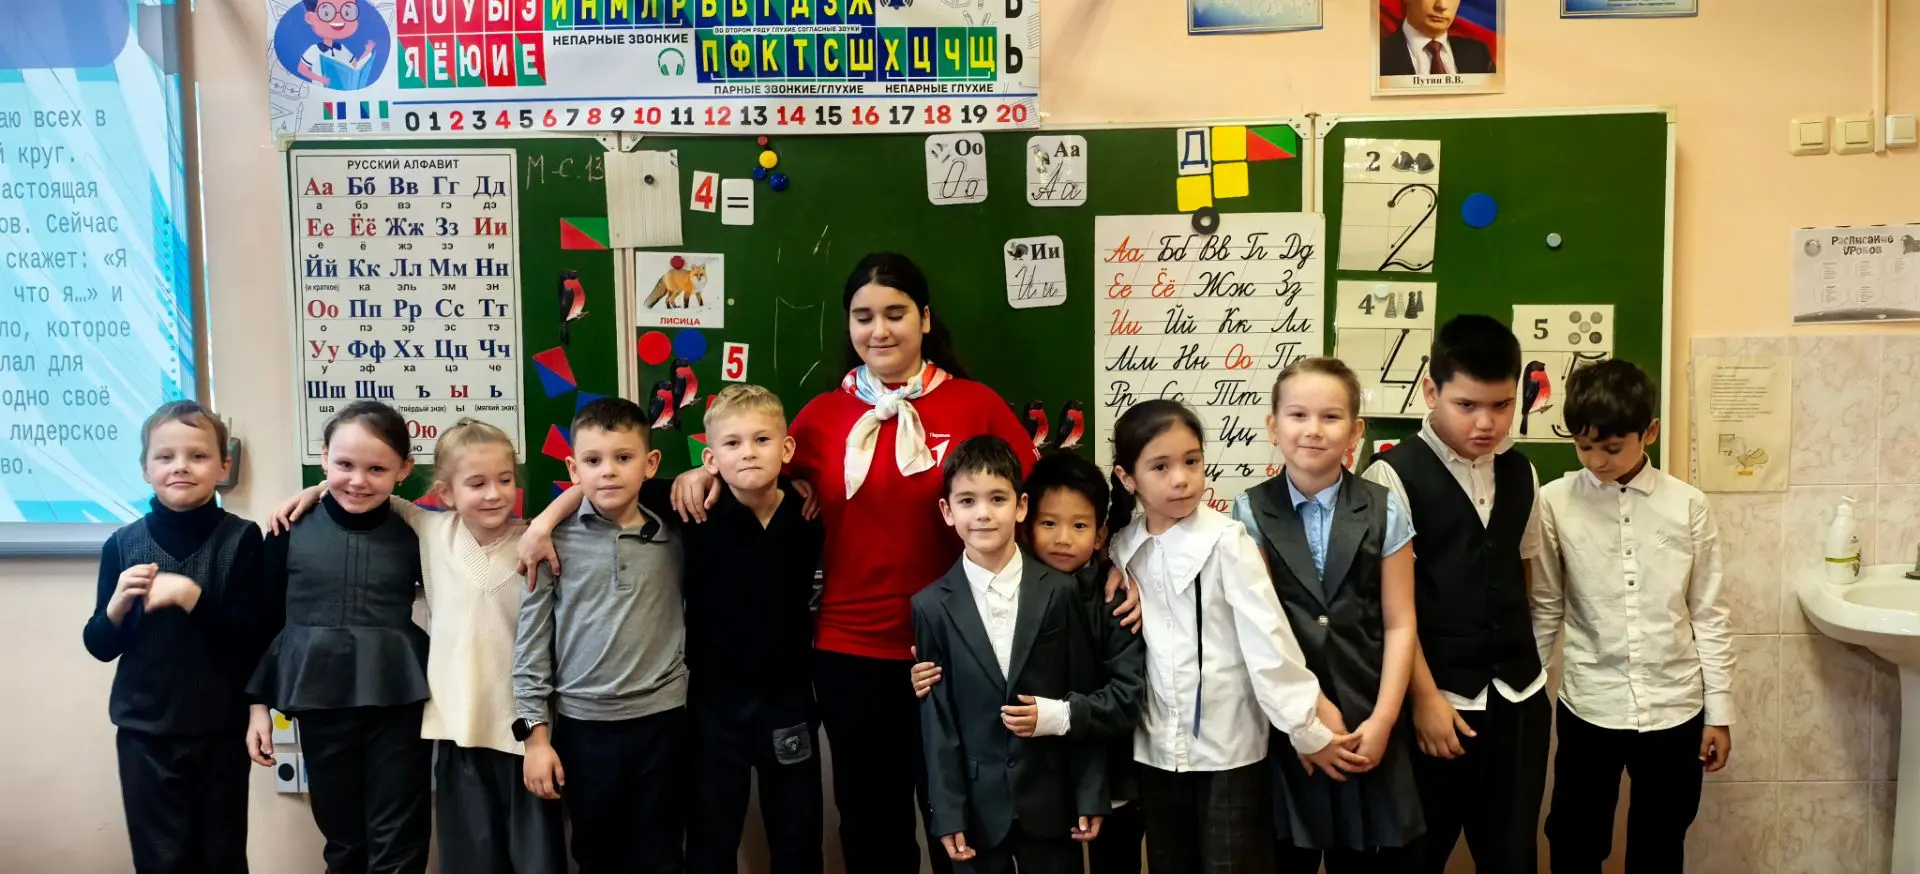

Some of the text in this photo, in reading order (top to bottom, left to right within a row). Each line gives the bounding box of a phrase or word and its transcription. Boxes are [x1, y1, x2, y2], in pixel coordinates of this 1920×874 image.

[553, 33, 688, 46] НЕПАРНЫЕ ЗВОНКИЕ
[404, 42, 538, 80] Я Ё Ю И Е
[702, 36, 995, 72] П Ф К Т С Ш Х Ц Ч Щ
[714, 84, 864, 94] ПАРНЫЕ ЗВОНКИЕ/ГЛУХИЕ
[886, 84, 994, 94] НЕПАРНЫЕ ГЛУХИЕ
[1413, 76, 1464, 86] Путин В.В.
[34, 110, 82, 128] всех
[96, 110, 106, 126] в
[405, 111, 420, 132] 0
[429, 112, 441, 130] 1
[450, 110, 464, 130] 2
[472, 110, 487, 130] 3
[495, 110, 511, 129] 4
[519, 110, 533, 128] 5
[542, 108, 557, 128] 6
[566, 108, 580, 126] 7
[586, 108, 602, 125] 8
[610, 107, 625, 124] 9
[633, 107, 662, 125] 10
[670, 107, 695, 126] 11
[704, 106, 732, 126] 12
[740, 106, 768, 126] 13
[776, 106, 806, 126] 14
[815, 106, 843, 126] 15
[852, 106, 880, 126] 16
[889, 105, 915, 125] 17
[924, 104, 952, 124] 18
[960, 104, 988, 124] 19
[996, 104, 1028, 123] 20
[18, 146, 75, 168] круг.
[954, 138, 983, 156] Оо
[1054, 141, 1081, 158] Аа
[1180, 130, 1209, 170] Д
[347, 158, 460, 170] РУССКИЙ АЛФАВИТ
[1366, 150, 1382, 172] 2
[0, 181, 98, 204] астоящая
[304, 176, 506, 199] Аа Бб Вв Гг Дд
[694, 175, 712, 210] 4
[356, 200, 497, 210] бэ дэ
[46, 212, 118, 233] Сейчас
[306, 213, 508, 236] Ее Ёё Жж Зз Ии
[6, 248, 127, 268] скажет: «Я
[1031, 243, 1061, 260] Ии
[1104, 232, 1314, 270] Аа Бб Вв Гг Дд
[306, 254, 509, 278] Йй Кк Лл Мм Нн
[14, 286, 50, 302] что
[112, 286, 122, 302] и
[359, 284, 371, 292] ка
[442, 283, 456, 291] эм
[1108, 268, 1302, 306] Ее Ёё Жж Зз
[308, 299, 508, 322] Оо Пп Рр Сс Тт
[1358, 294, 1374, 315] 4
[47, 320, 130, 342] которое
[402, 324, 415, 334] эр
[660, 316, 700, 326] ЛИСИЦА
[1109, 304, 1312, 336] Ии Йй Кк Лл
[1533, 318, 1549, 340] 5
[308, 339, 511, 363] Уу Фф Хх Цц Чч
[1105, 343, 1254, 371] Мм Нн Оо
[48, 354, 84, 376] для
[360, 364, 502, 374] эф ха цэ че
[726, 346, 744, 379] 5
[2, 386, 110, 412] одно своё
[1206, 380, 1262, 406] Тт
[319, 405, 334, 413] ша
[10, 424, 118, 446] лидерское
[1219, 415, 1258, 448] Цц
[0, 458, 32, 474] во.
